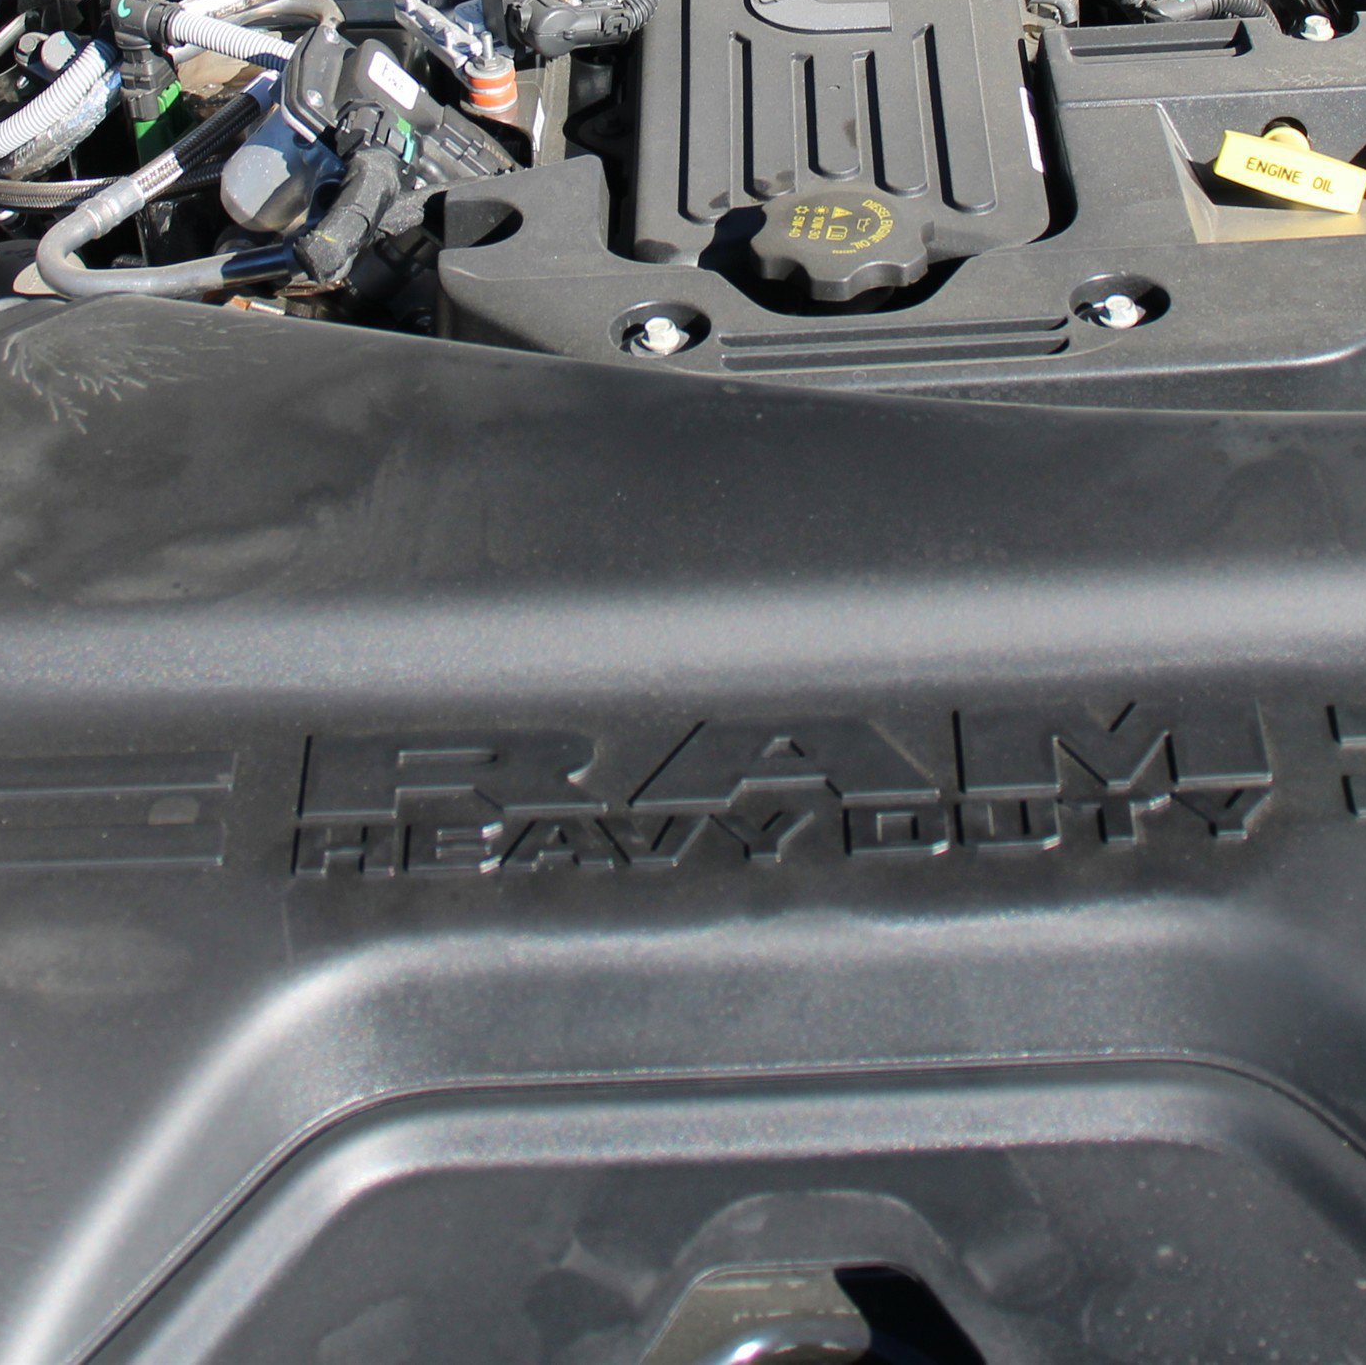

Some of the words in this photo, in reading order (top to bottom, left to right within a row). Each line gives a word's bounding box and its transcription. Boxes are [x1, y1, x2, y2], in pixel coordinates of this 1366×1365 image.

[1245, 156, 1303, 185] ENGINE
[1312, 176, 1335, 195] OIL
[861, 198, 892, 220] DIESEL
[788, 215, 806, 238] 5W-40
[867, 219, 894, 244] ENGINE
[850, 238, 871, 250] OIL
[295, 700, 1273, 820] RAM
[290, 809, 815, 875] HEAVY
[842, 791, 1272, 857] DUTY
